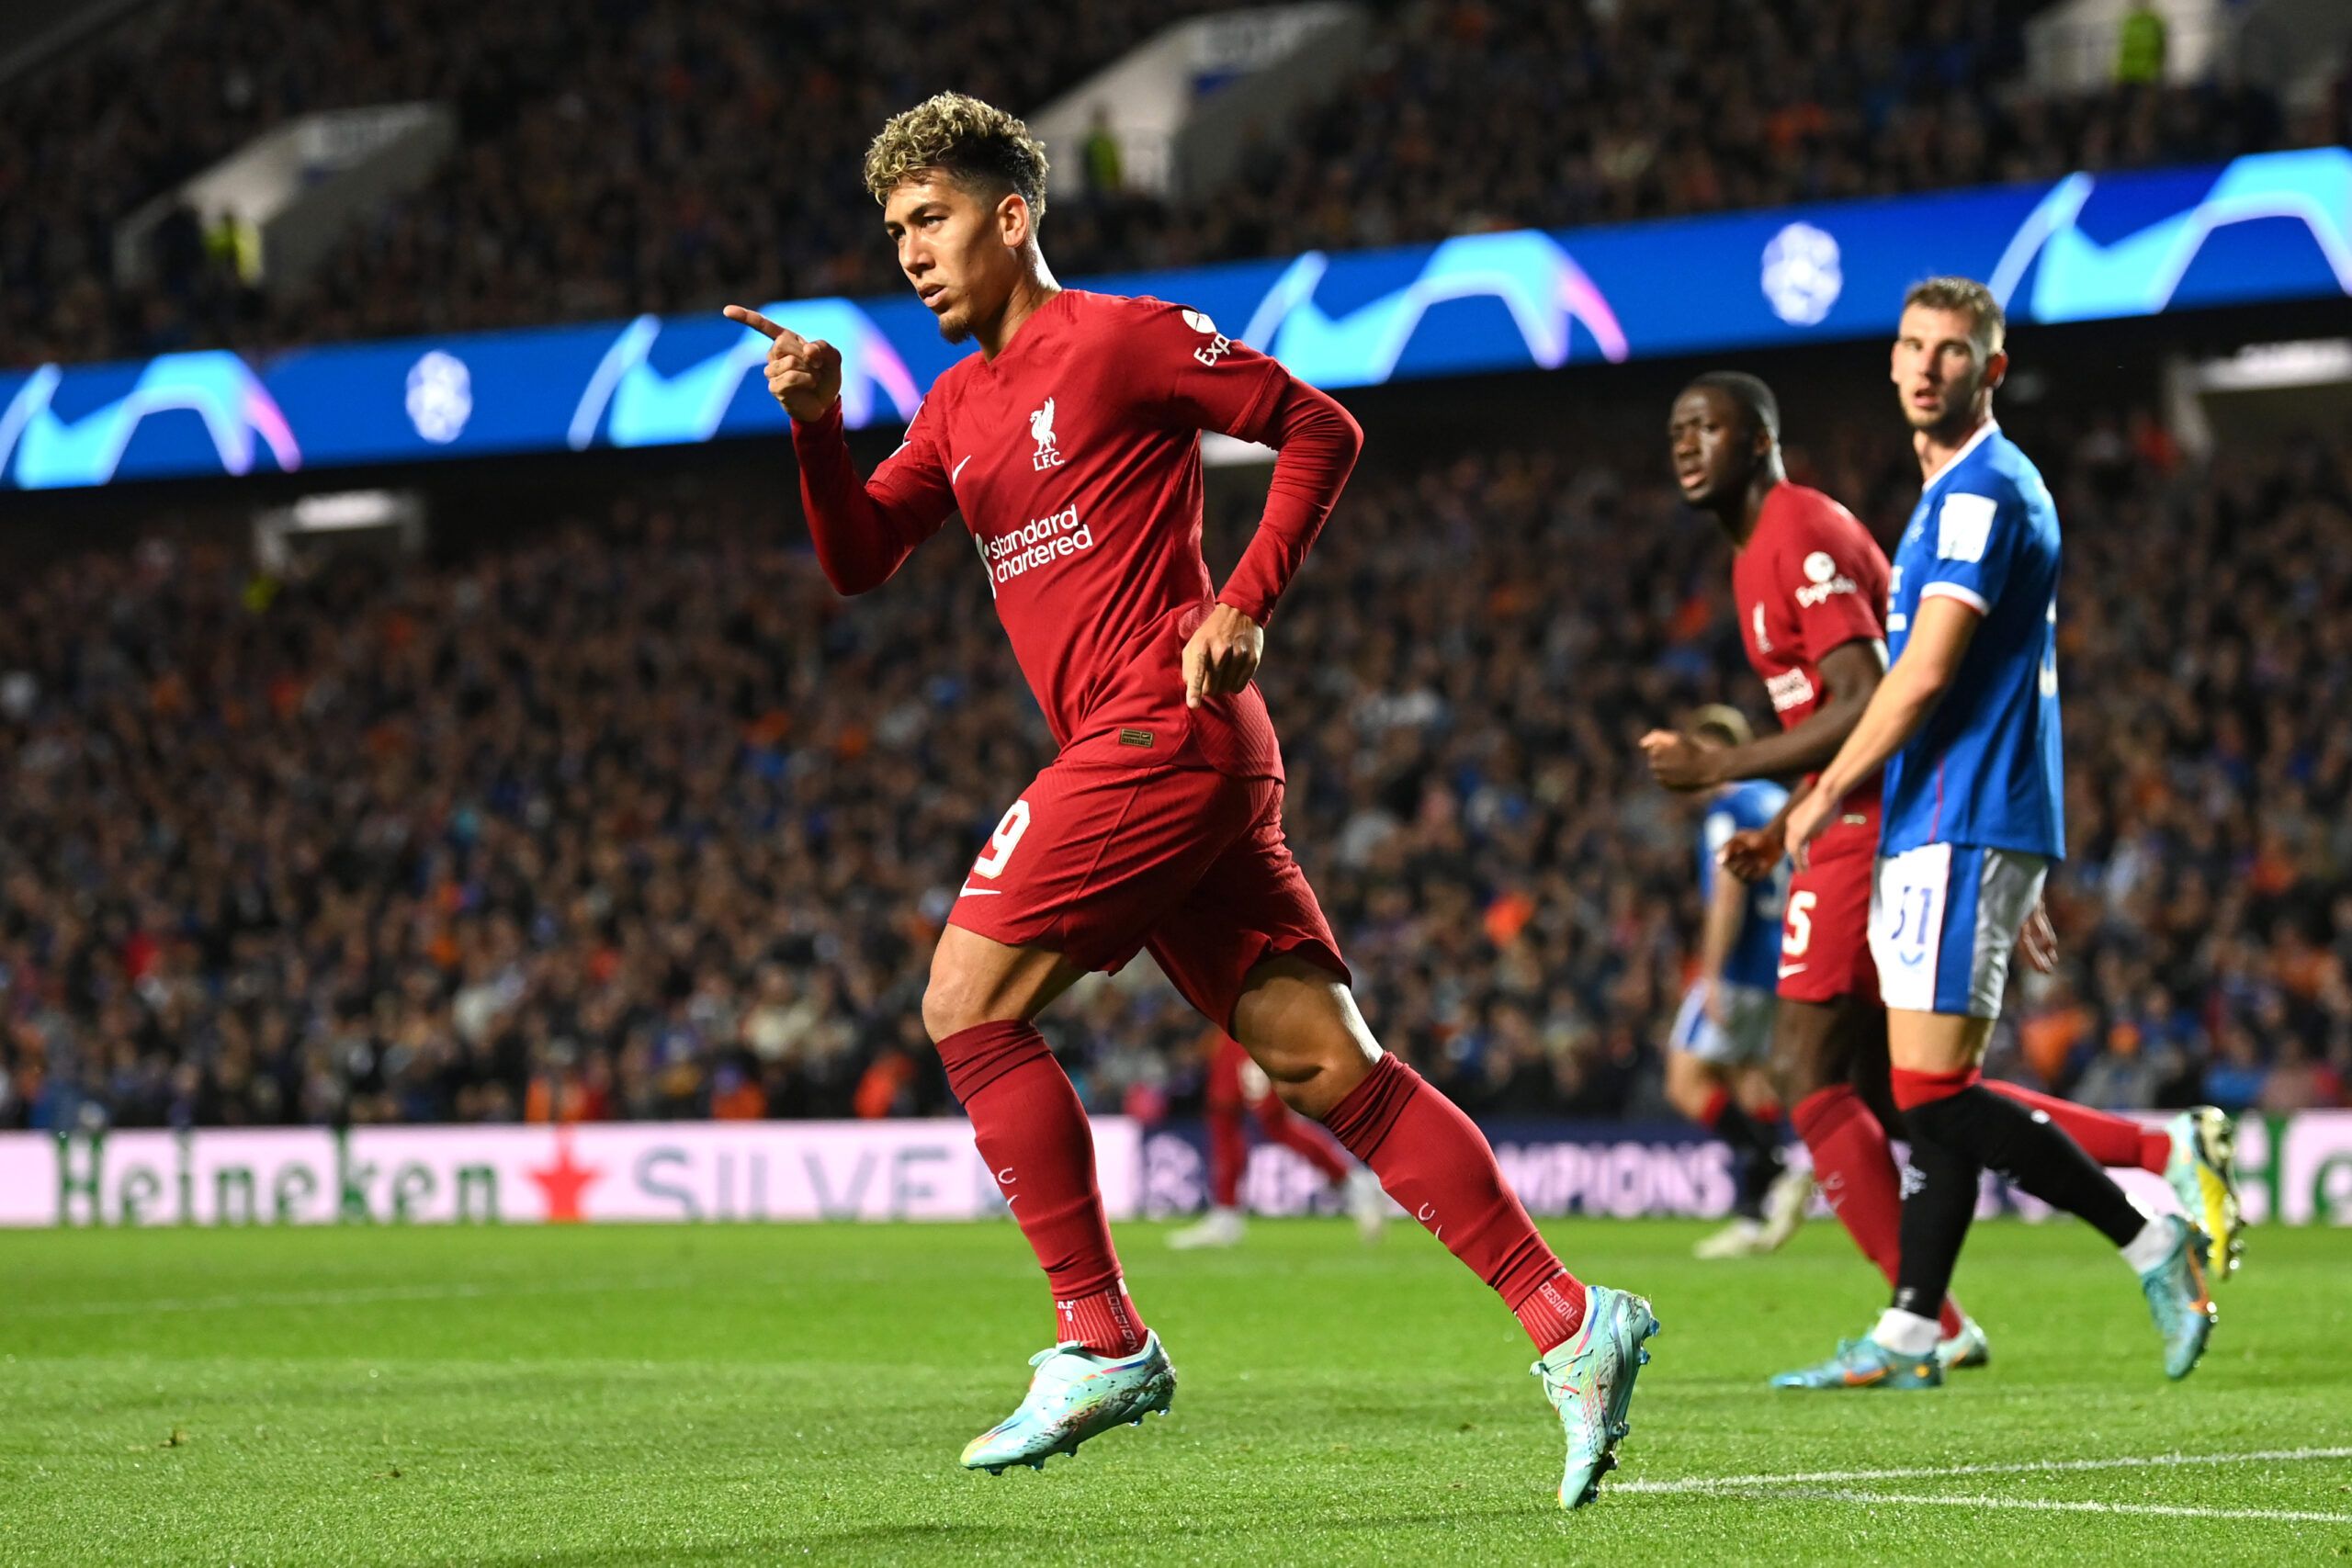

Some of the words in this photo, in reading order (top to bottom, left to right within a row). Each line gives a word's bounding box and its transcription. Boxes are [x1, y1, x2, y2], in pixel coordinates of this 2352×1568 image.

[990, 503, 1079, 559] standard
[997, 524, 1093, 583] chartered
[974, 799, 1030, 879] 9
[1781, 889, 1817, 956] 5
[55, 1127, 503, 1228] Heineken
[632, 1145, 1009, 1222] SILVE
[1539, 1281, 1577, 1321] DESIGN
